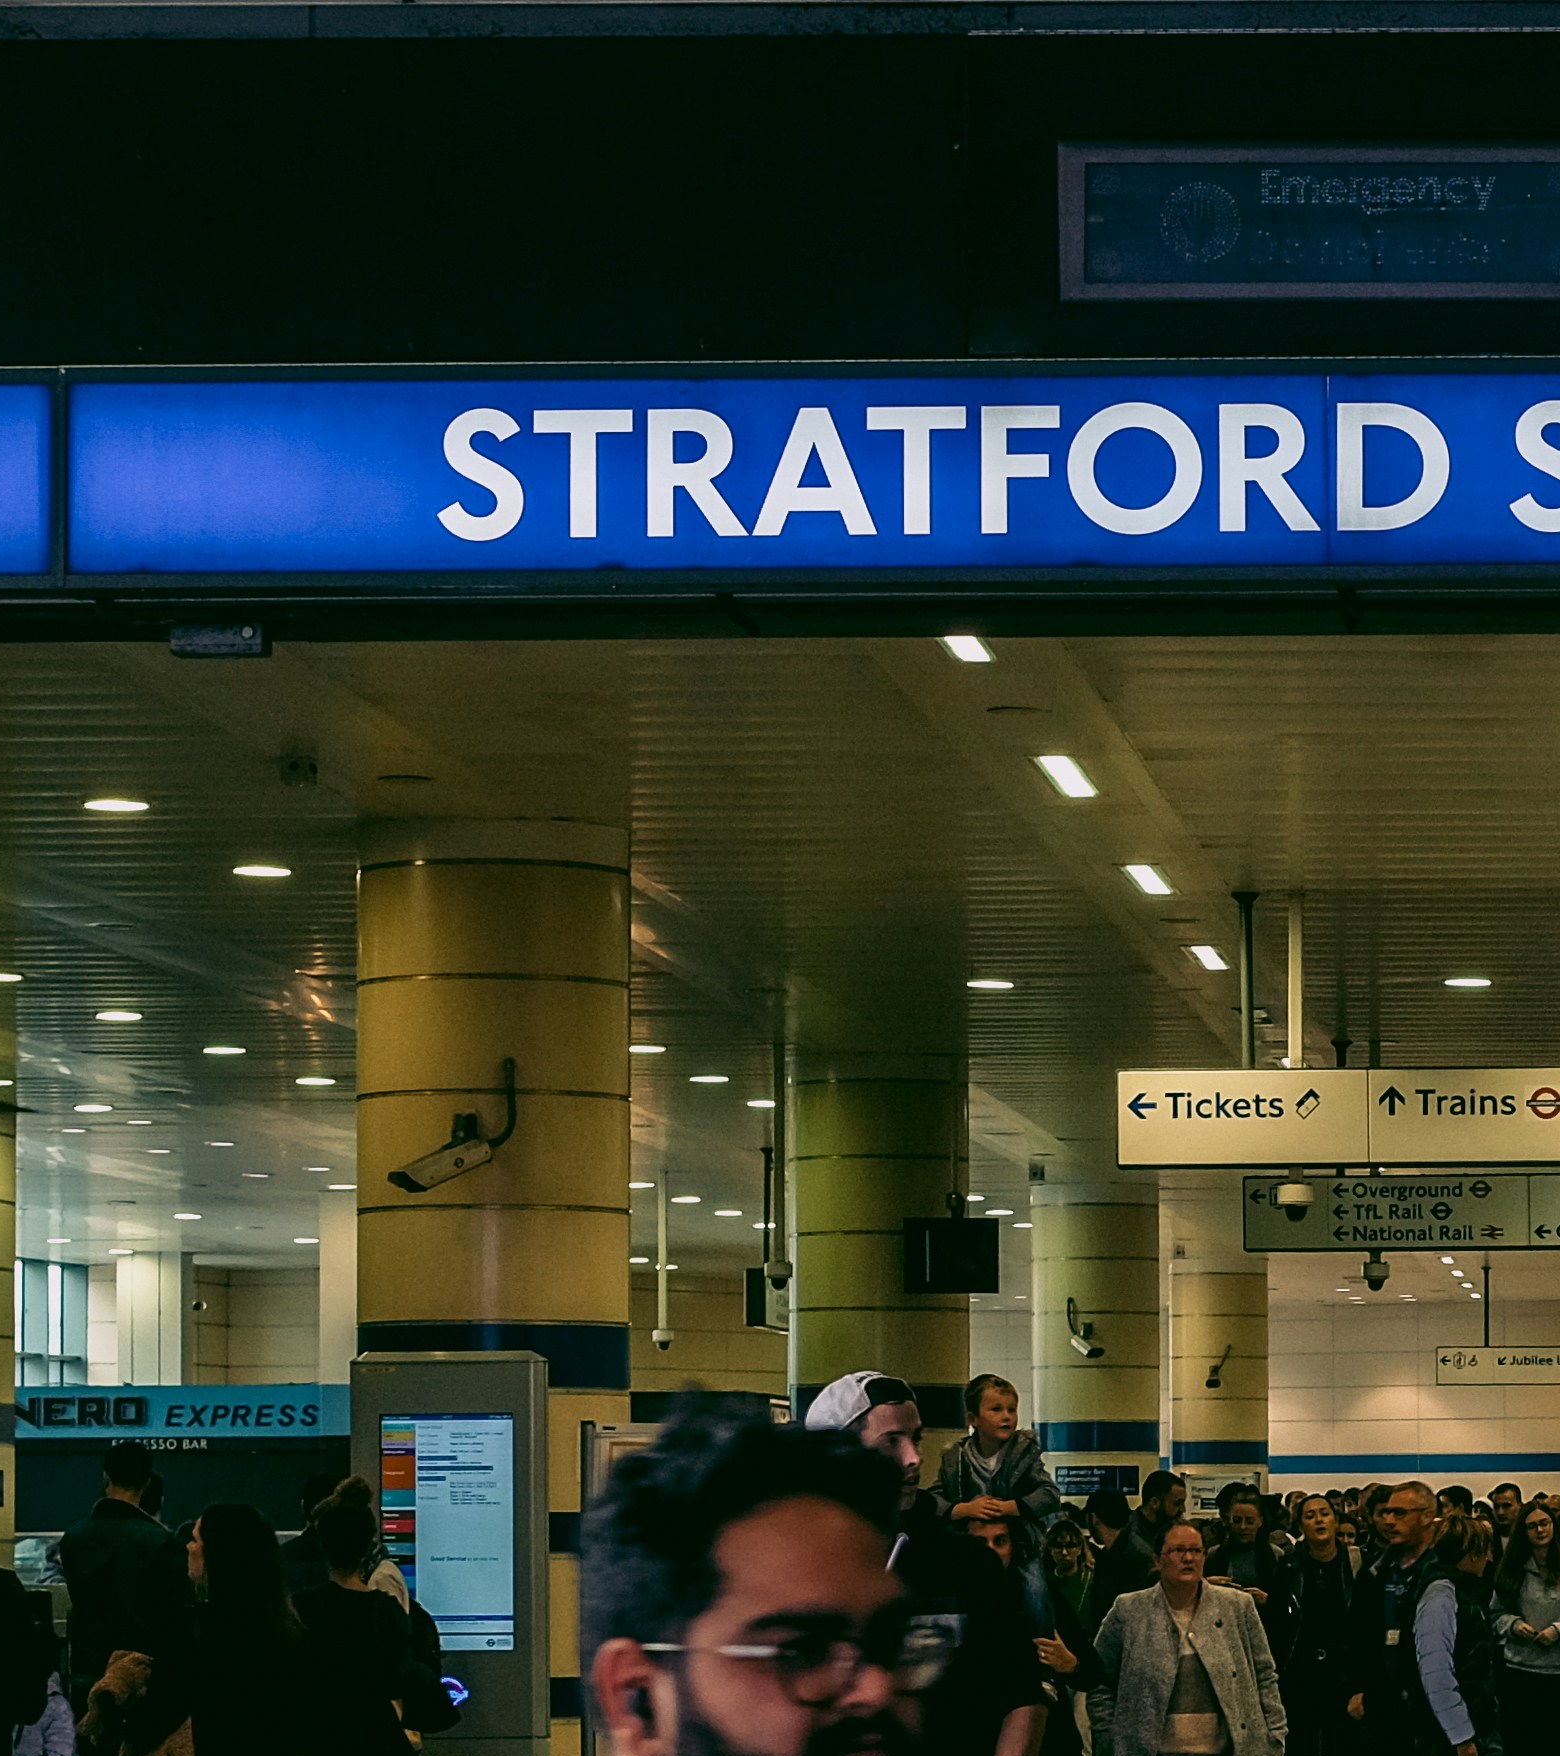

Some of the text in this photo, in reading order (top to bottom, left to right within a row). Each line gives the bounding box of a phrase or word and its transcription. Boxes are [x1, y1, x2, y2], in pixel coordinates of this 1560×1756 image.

[1259, 168, 1497, 216] Emergency
[437, 402, 1449, 542] STRATFORD
[1165, 1091, 1284, 1119] Tickets
[1415, 1088, 1517, 1116] Trains
[1352, 1181, 1463, 1203] Overground
[1352, 1203, 1423, 1221] TfL Rail
[1352, 1224, 1474, 1242] National Rail
[1509, 1356, 1553, 1366] Jubilee
[15, 1396, 320, 1429] NERO EXPRESS
[111, 1438, 208, 1451] EESSO BAR
